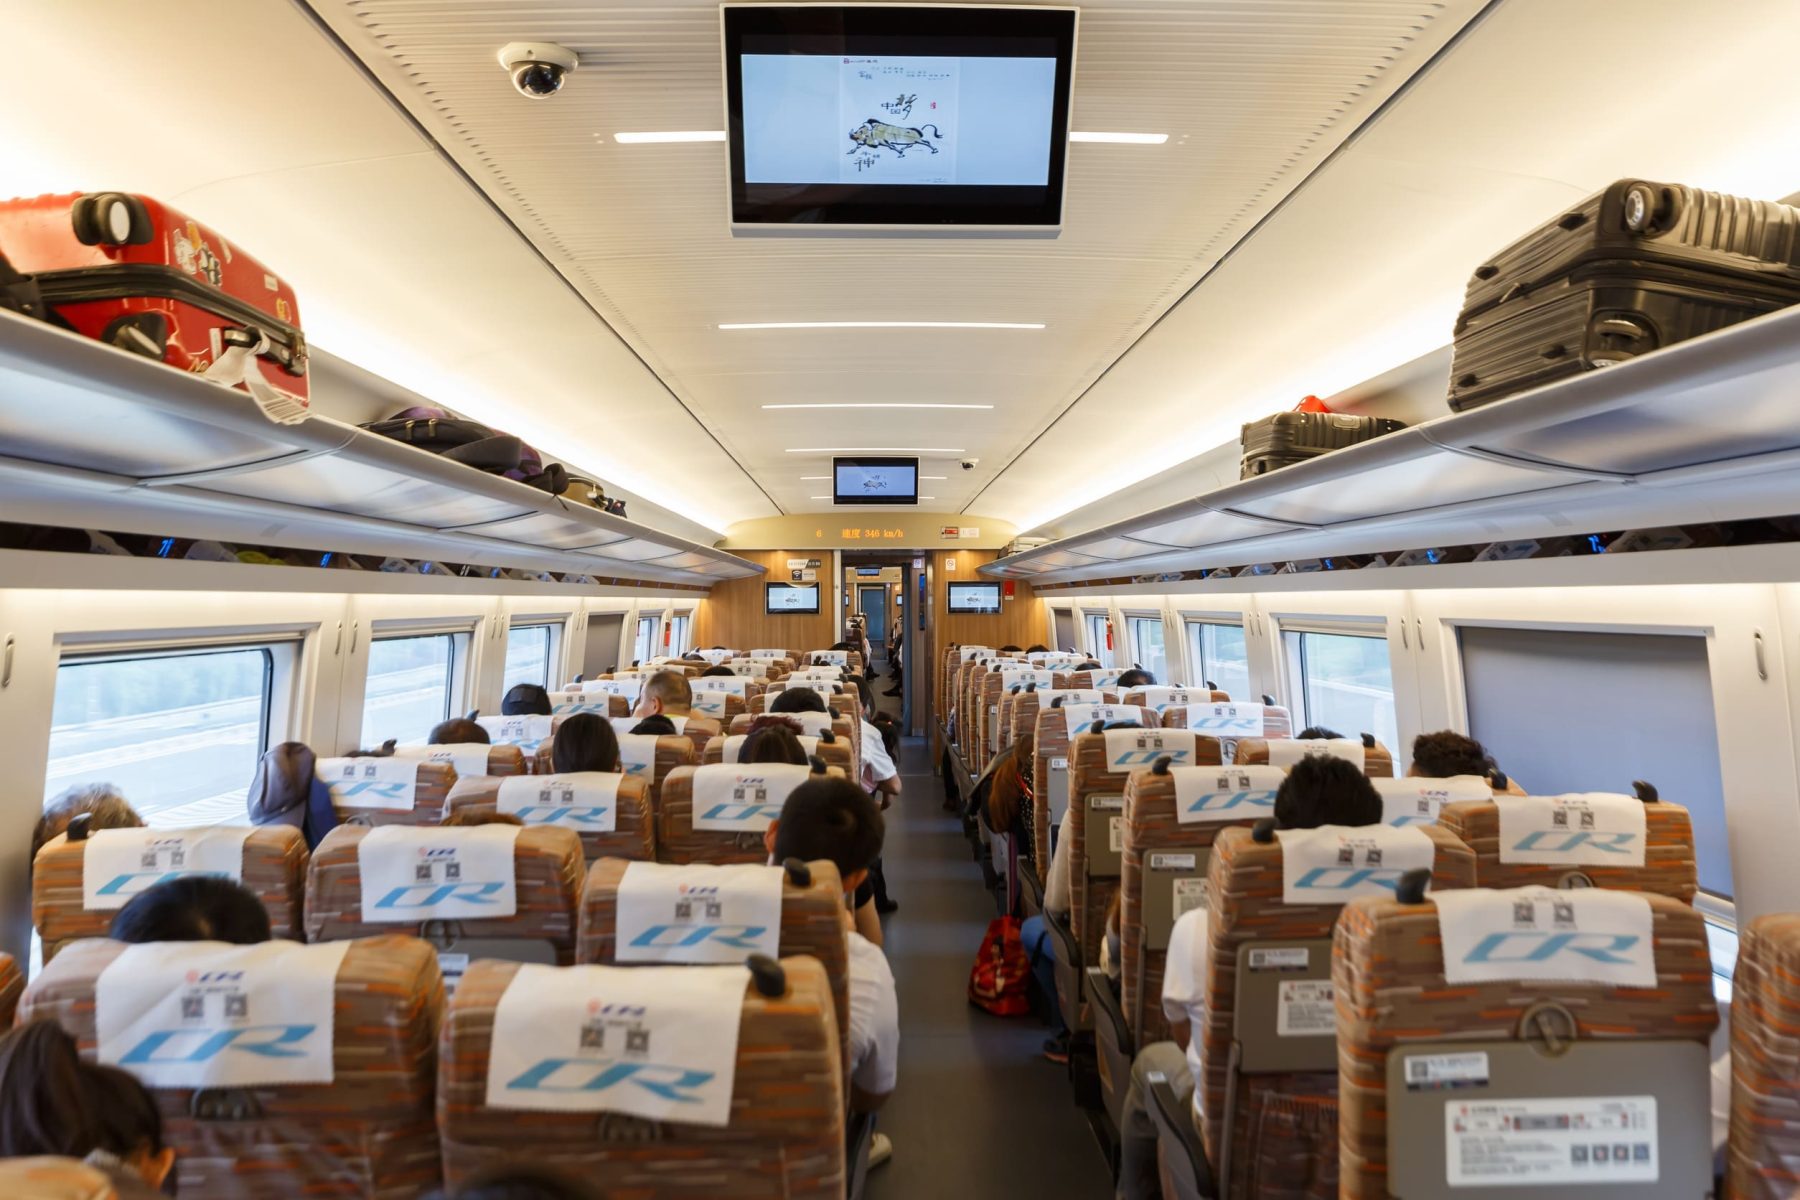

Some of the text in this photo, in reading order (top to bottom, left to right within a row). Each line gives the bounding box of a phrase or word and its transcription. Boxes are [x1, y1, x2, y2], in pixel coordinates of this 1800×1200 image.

[1193, 718, 1257, 729] CR
[1114, 750, 1190, 765] CR
[510, 806, 608, 824] CR
[1512, 830, 1637, 854] CR
[374, 882, 505, 908] CR
[628, 925, 767, 948] CR
[1461, 931, 1640, 965] CR
[118, 1024, 317, 1064] CR
[506, 1058, 715, 1104] CR
